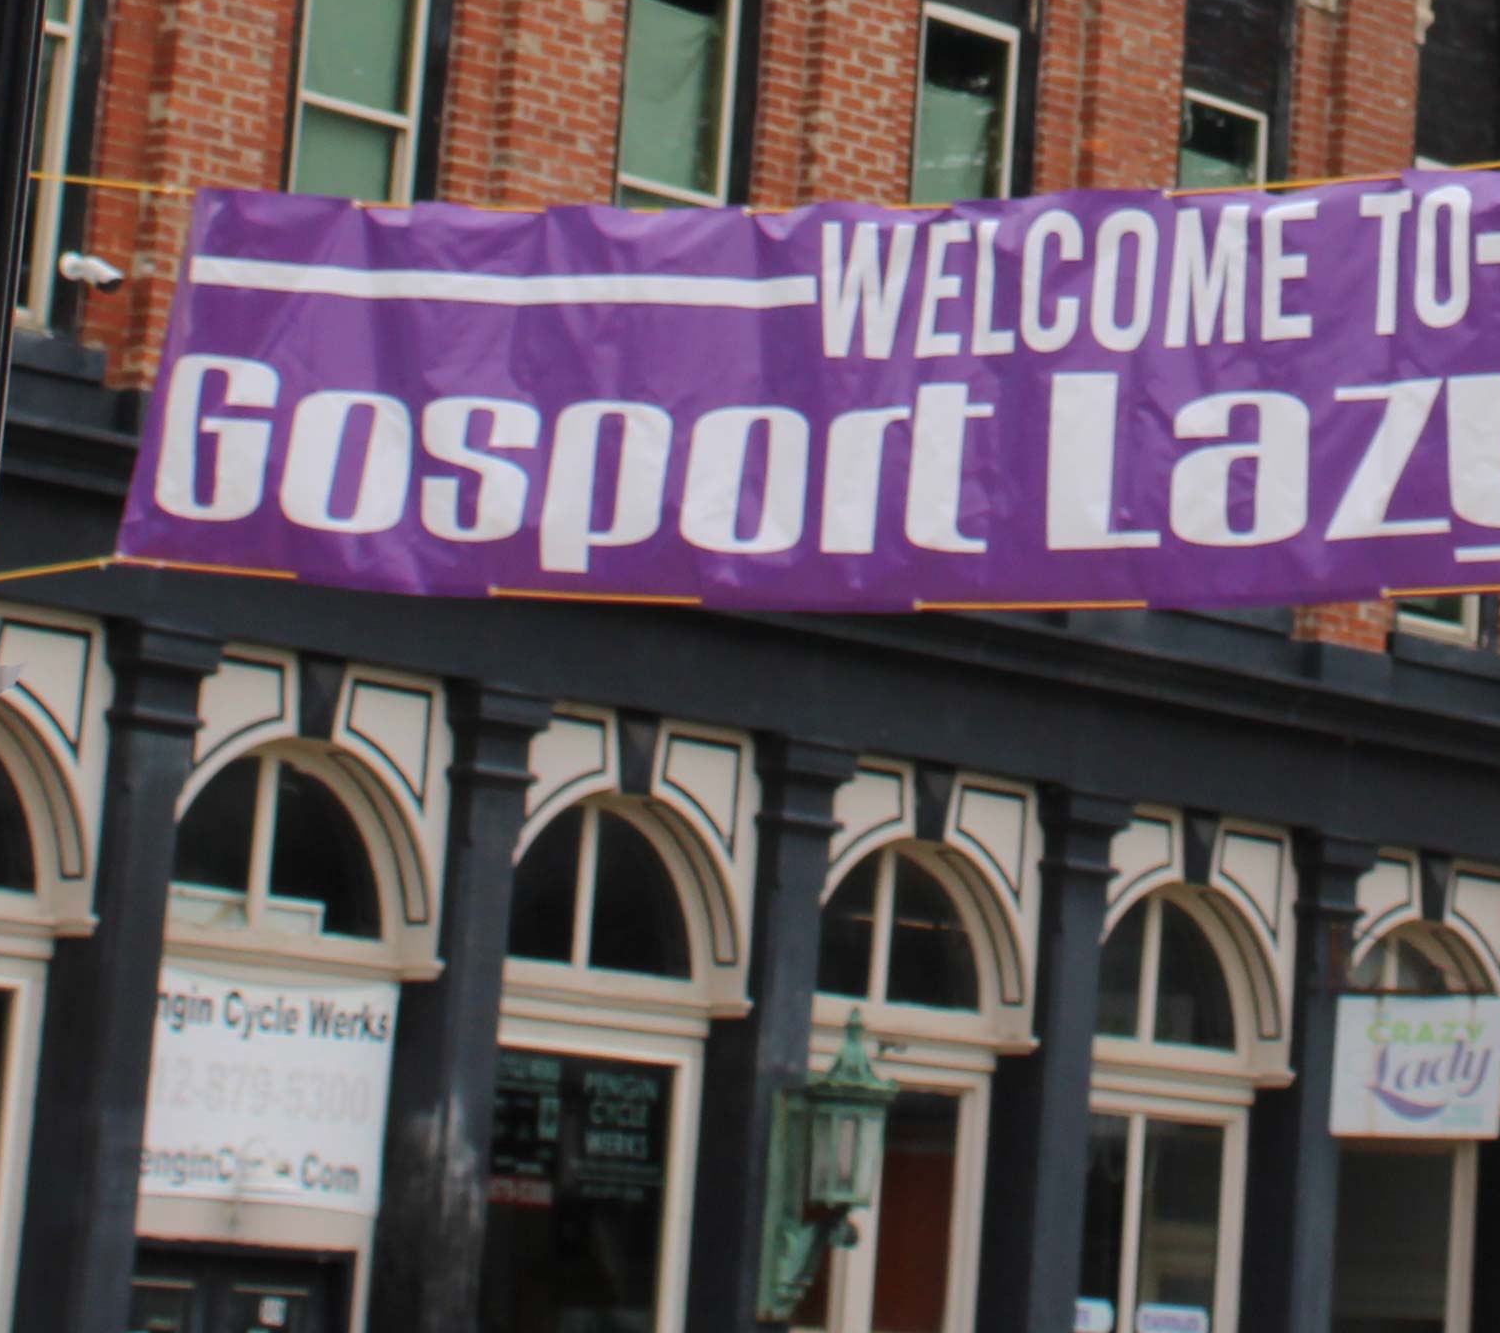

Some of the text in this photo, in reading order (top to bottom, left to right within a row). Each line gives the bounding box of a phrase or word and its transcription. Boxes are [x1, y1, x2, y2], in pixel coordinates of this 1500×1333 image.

[821, 182, 1473, 359] WELCOME TO
[155, 354, 994, 572] Gosport
[223, 990, 299, 1041] Cycle
[309, 996, 389, 1043] Werks
[1365, 1019, 1486, 1046] CRAZY
